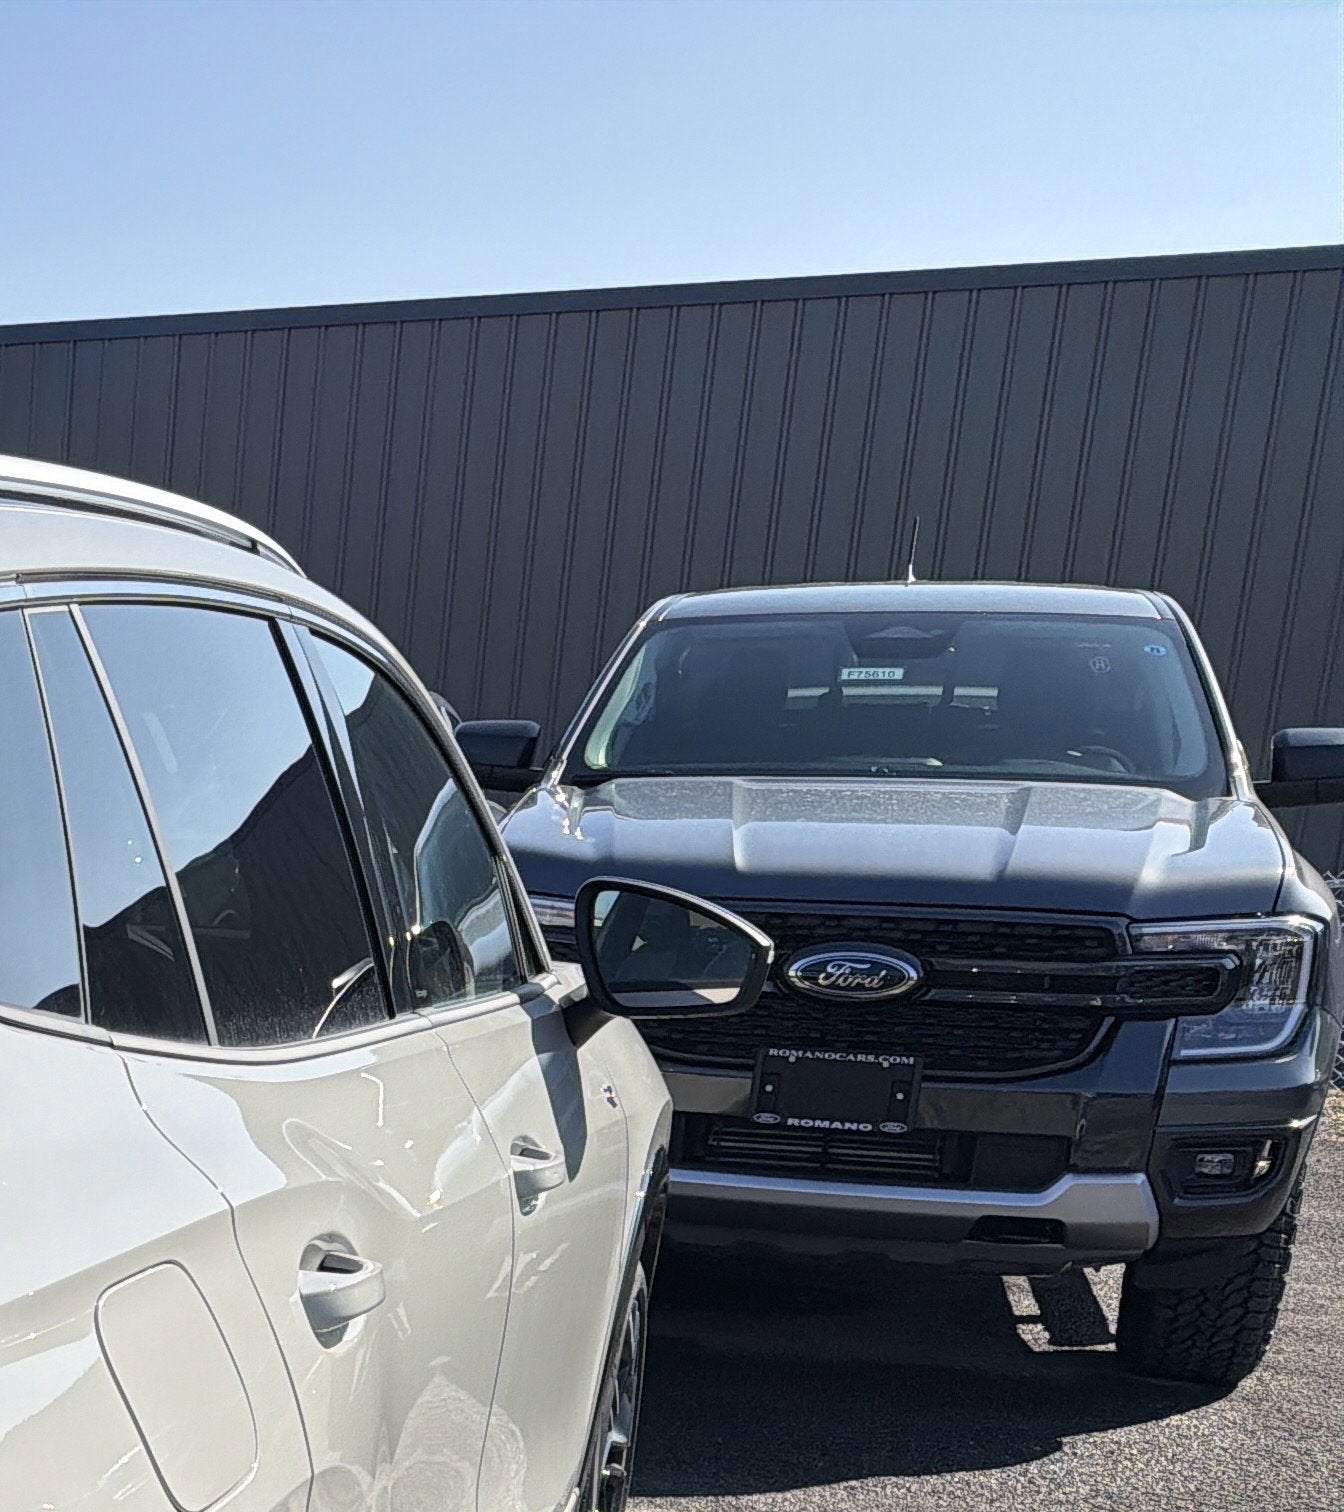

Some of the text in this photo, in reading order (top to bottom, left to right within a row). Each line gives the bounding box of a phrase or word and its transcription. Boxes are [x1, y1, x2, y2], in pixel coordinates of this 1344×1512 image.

[847, 670, 896, 679] F75610
[817, 960, 888, 988] Ford
[768, 1048, 915, 1066] ROMANOCARS.COM
[786, 1117, 874, 1132] ROMANO
